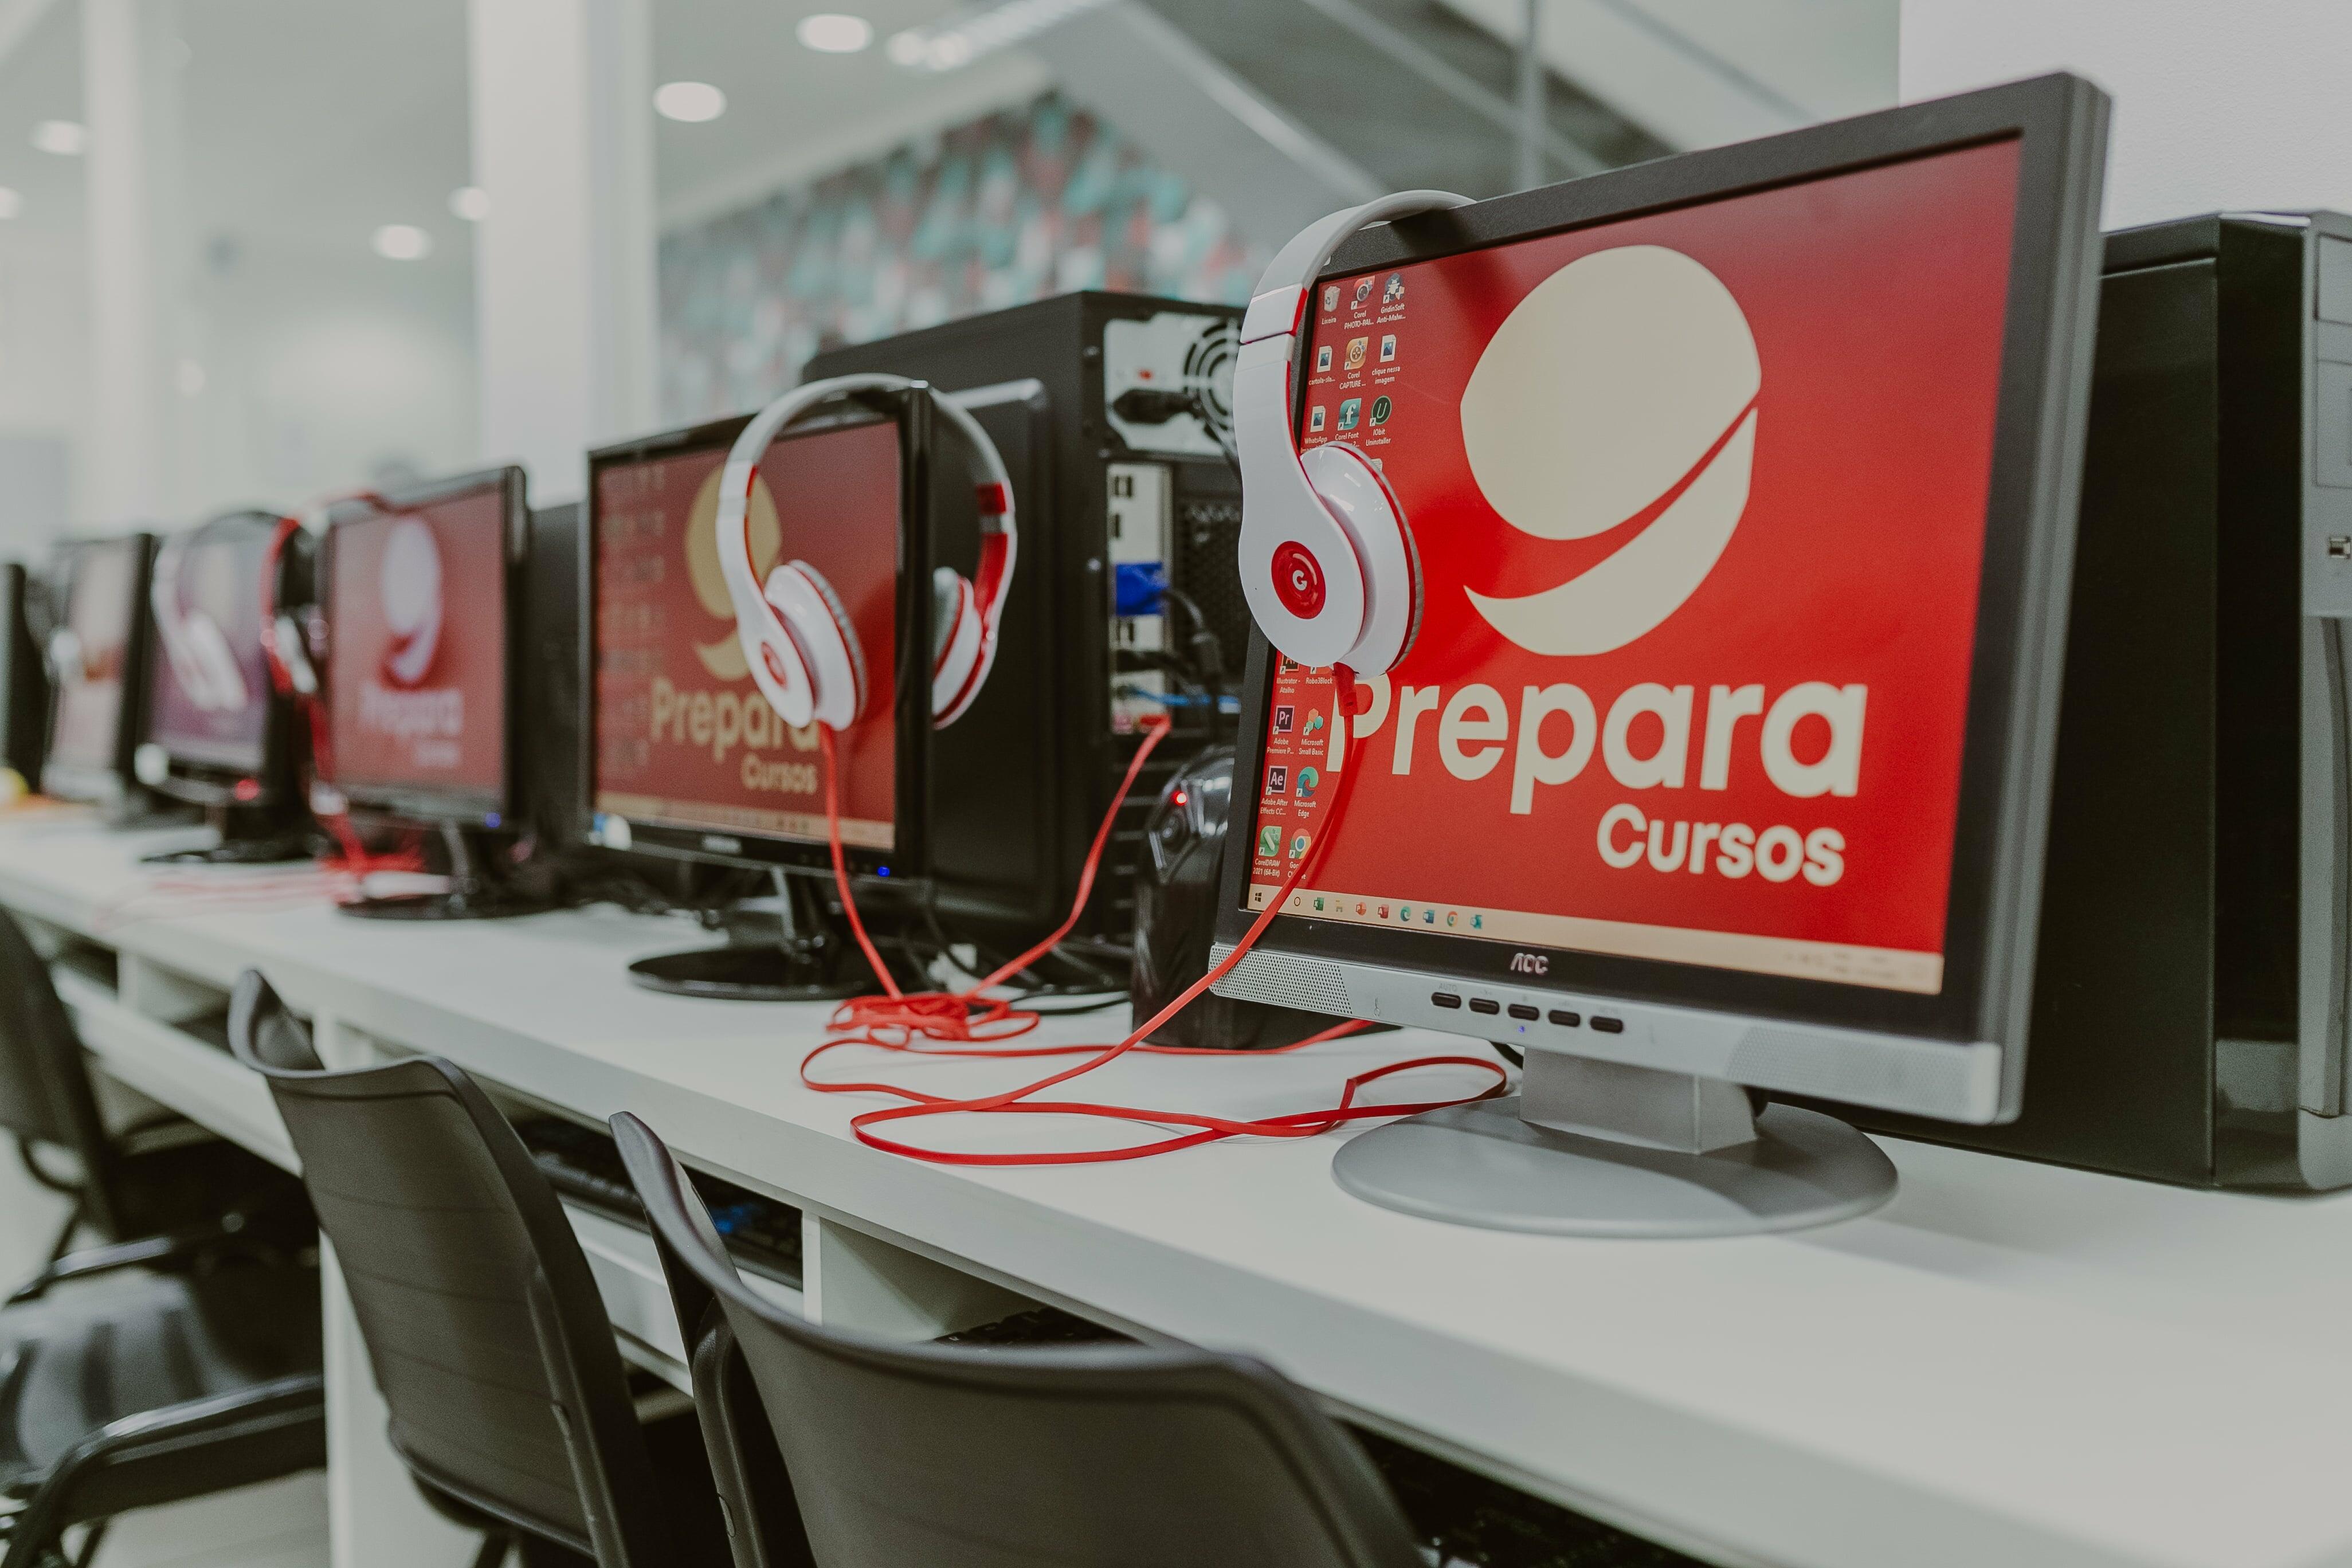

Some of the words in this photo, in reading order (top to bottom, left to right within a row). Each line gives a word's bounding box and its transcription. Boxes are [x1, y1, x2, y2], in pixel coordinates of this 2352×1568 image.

[1381, 303, 1405, 313] GridinSoft
[1354, 310, 1367, 319] Corel
[1348, 371, 1361, 379] Corel
[1372, 367, 1386, 376] clique
[1387, 366, 1401, 374] nessa
[1339, 380, 1362, 390] CAPTURE
[1375, 377, 1395, 385] imagem
[1304, 436, 1327, 444] WhatsApp
[1335, 433, 1347, 441] Corel
[1366, 437, 1391, 446] Uninstaller
[1292, 570, 1307, 591] G
[1279, 711, 1289, 725] Pr
[1326, 673, 1868, 814] Prepara
[1267, 746, 1287, 754] Premiere
[1270, 771, 1284, 786] Ae
[1276, 798, 1288, 806] After
[1297, 809, 1310, 818] Edge
[1597, 803, 1846, 887] Cursos
[1255, 859, 1280, 867] CorelDRAW
[1263, 869, 1280, 877] (64-Bit)
[1510, 952, 1549, 975] AOC
